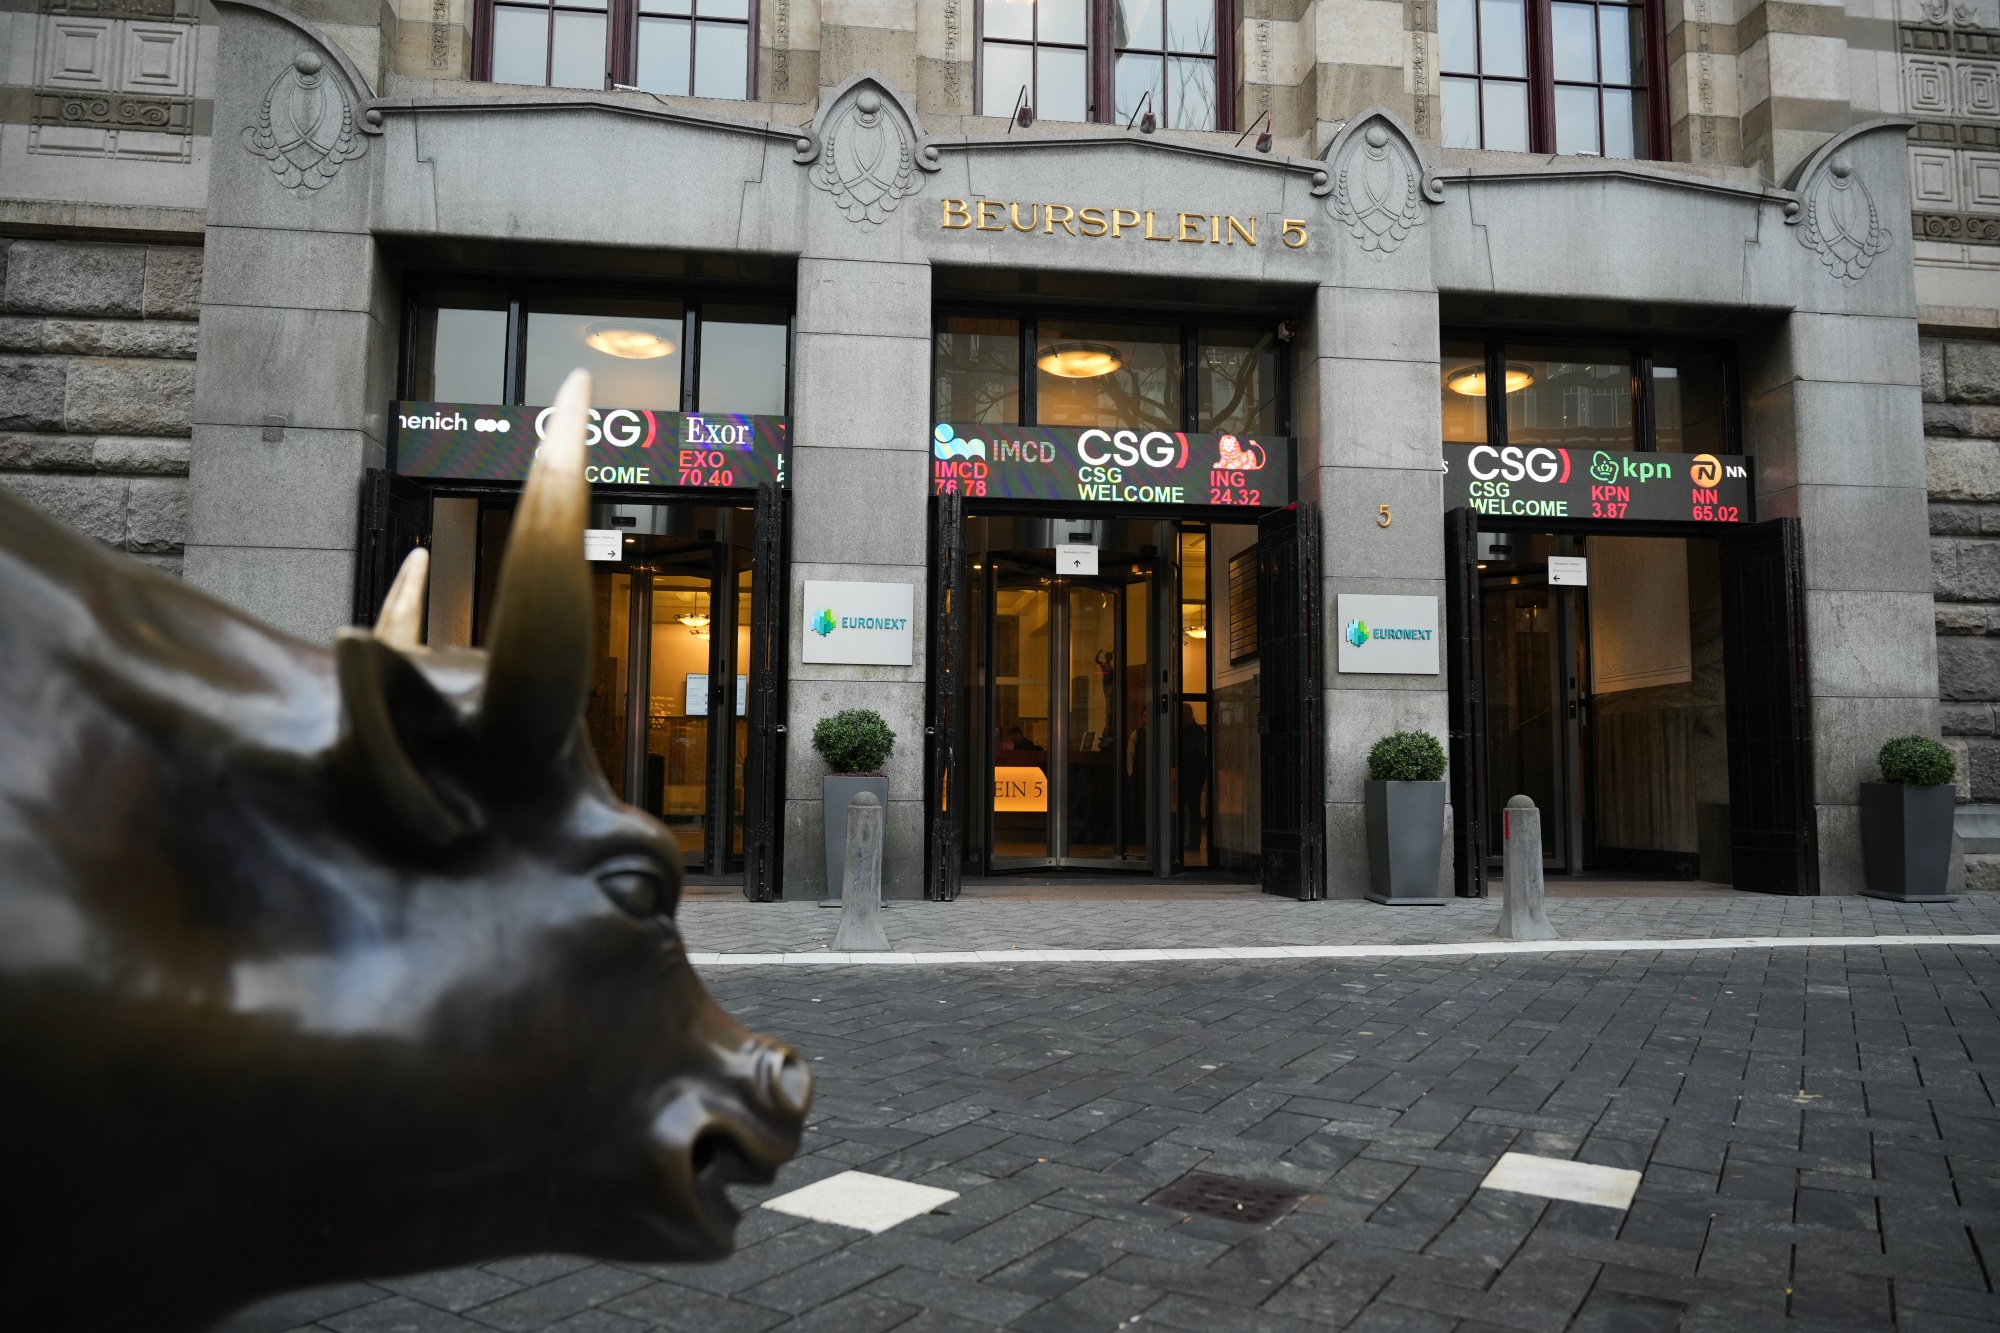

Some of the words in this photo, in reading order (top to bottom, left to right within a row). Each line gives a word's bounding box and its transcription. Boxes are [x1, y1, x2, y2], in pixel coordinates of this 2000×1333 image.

[941, 198, 1257, 247] BEURSPLEIN
[1281, 218, 1308, 249] 5
[685, 416, 749, 445] Exor
[679, 450, 725, 468] EXO
[993, 439, 1056, 463] IMCD
[584, 465, 650, 485] COME
[678, 469, 733, 487] 70.40
[934, 461, 989, 479] IMCD
[1078, 467, 1122, 484] CSG
[1623, 456, 1672, 483] kpn
[934, 478, 987, 497] 7678
[1210, 470, 1245, 488] ING
[1078, 484, 1184, 504] WELCOME
[1210, 488, 1260, 506] 24.32
[1469, 481, 1510, 497] CSG
[1591, 485, 1630, 502] KPN
[1692, 488, 1718, 505] NN
[1469, 497, 1568, 517] WELCOME
[1591, 502, 1627, 519] 3.87
[1692, 505, 1738, 522] 65.02
[1376, 504, 1393, 529] 5
[842, 617, 907, 630] EURONEXT
[1373, 628, 1432, 640] EURONEXT
[1033, 781, 1042, 798] 5
